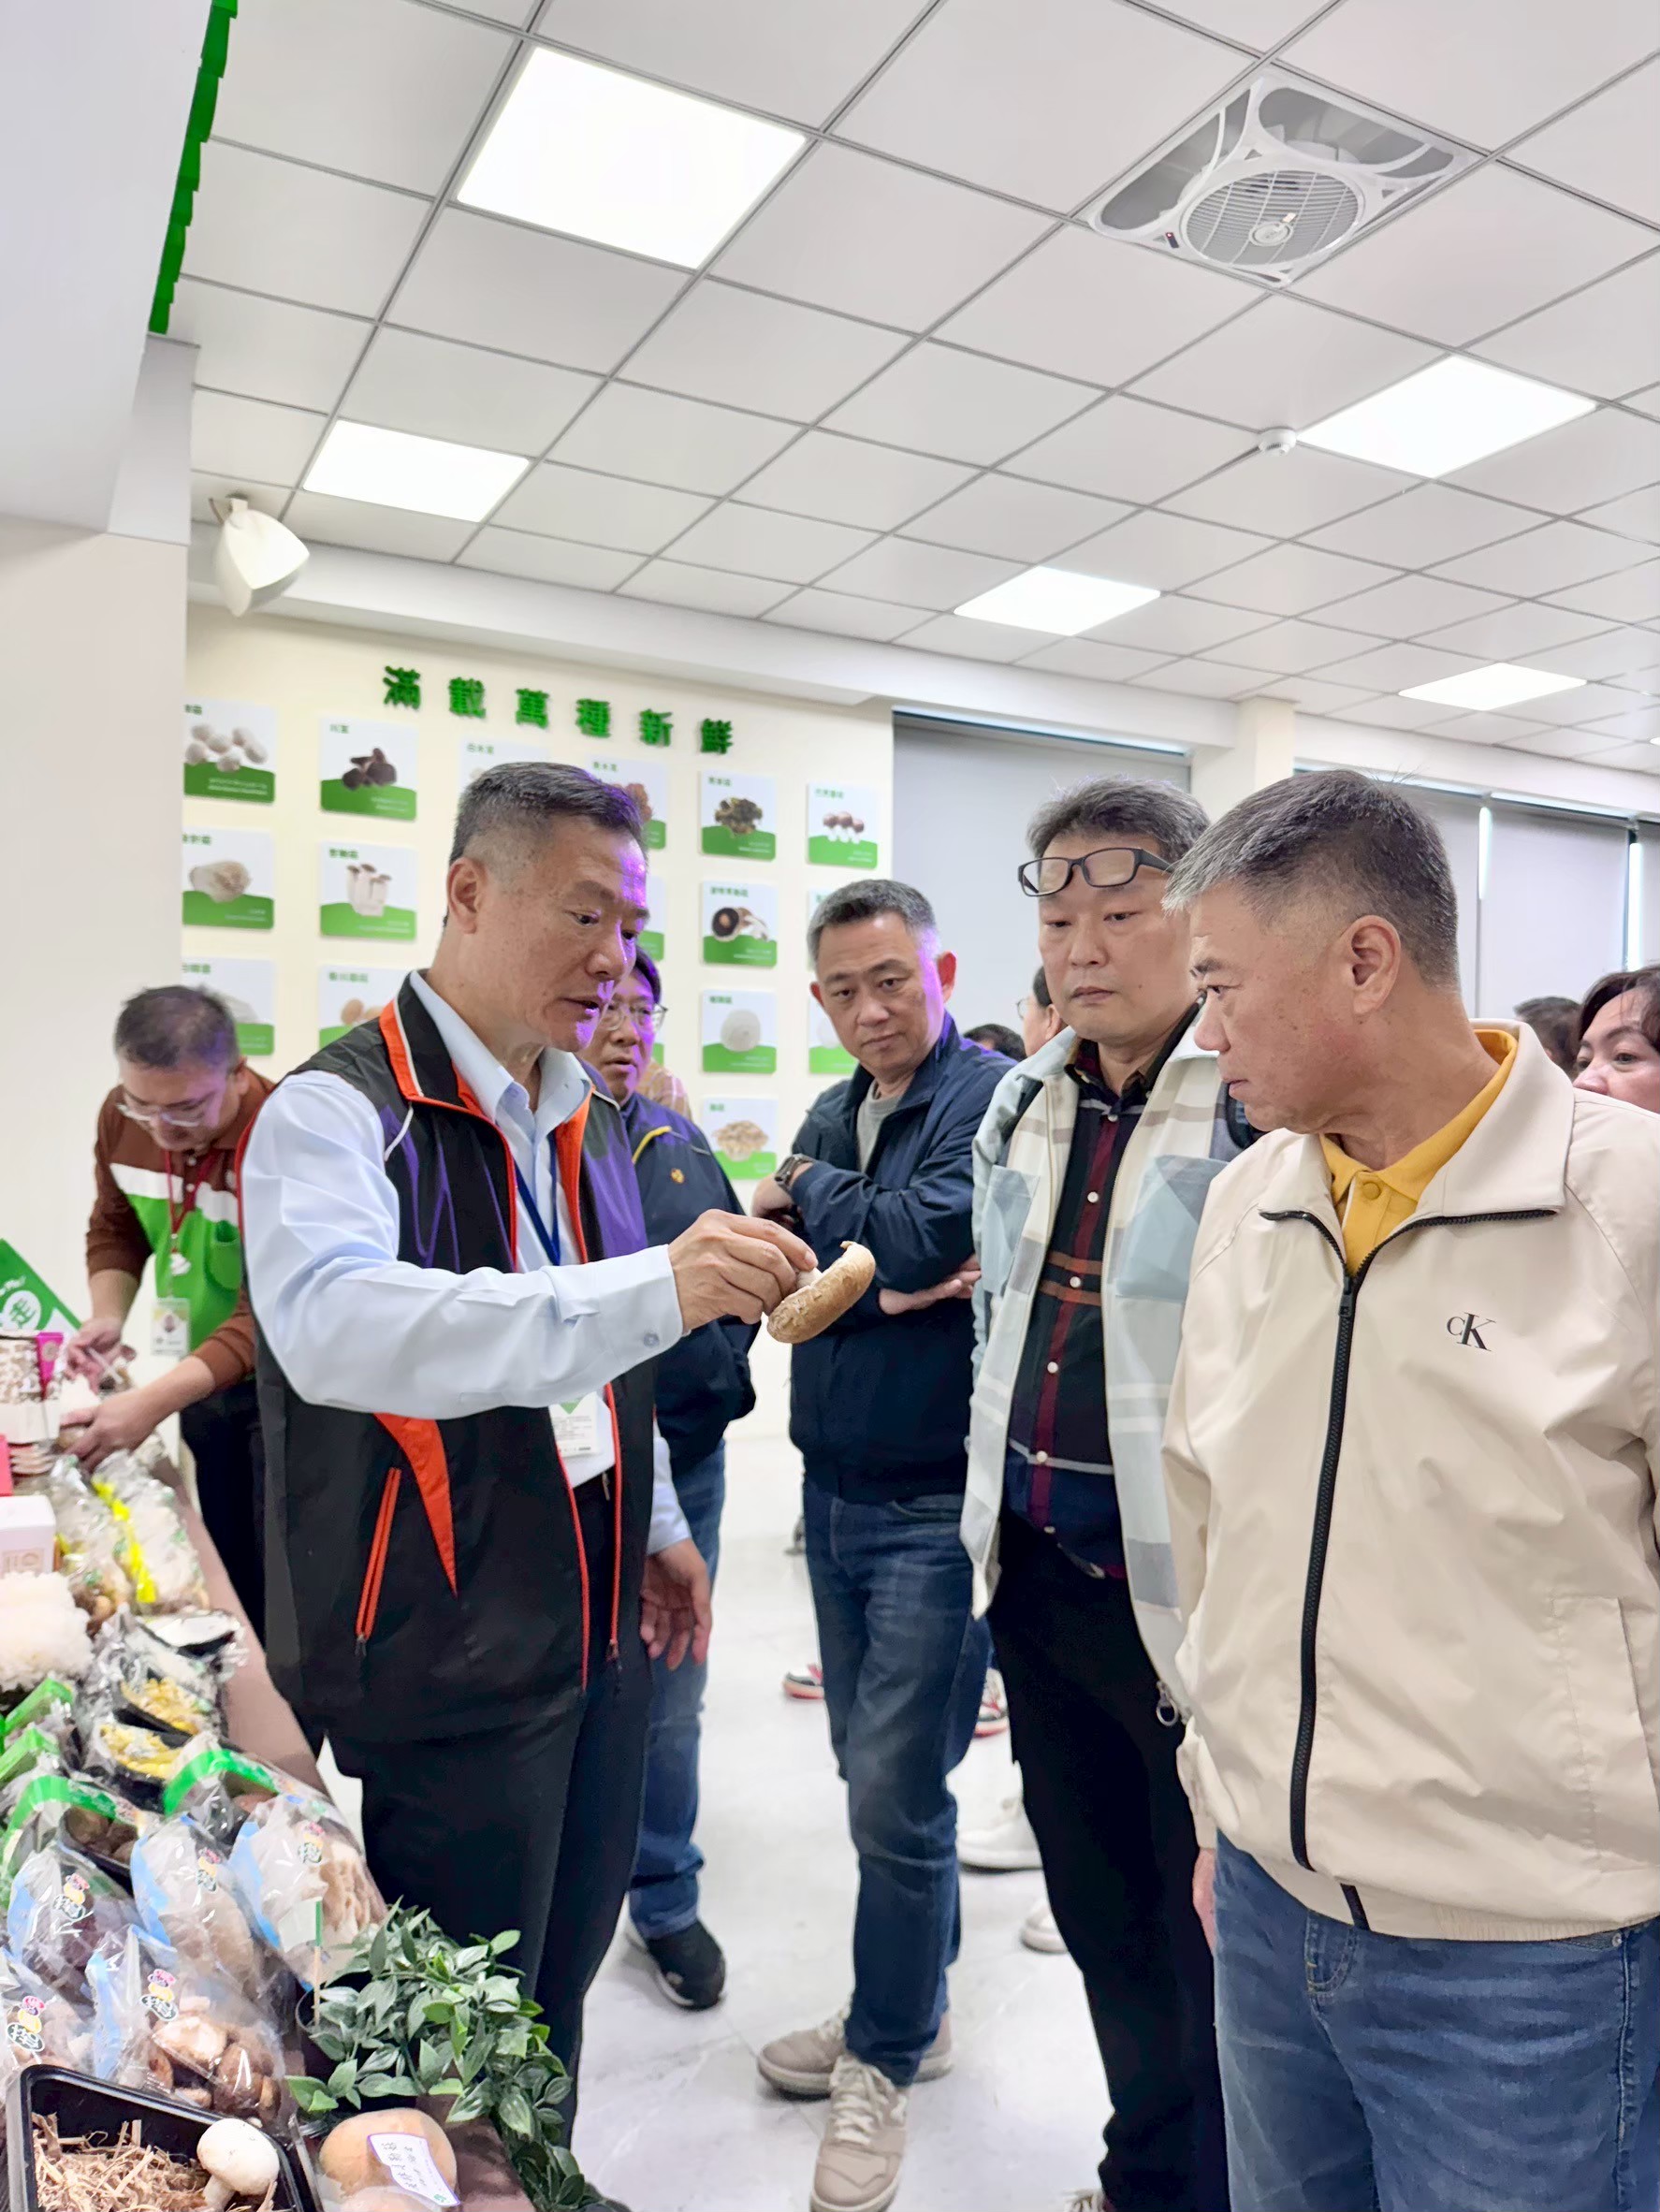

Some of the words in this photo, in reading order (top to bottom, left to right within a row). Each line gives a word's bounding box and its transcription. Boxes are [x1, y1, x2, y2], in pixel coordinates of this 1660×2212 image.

[384, 665, 733, 754] 滿載萬種新鮮
